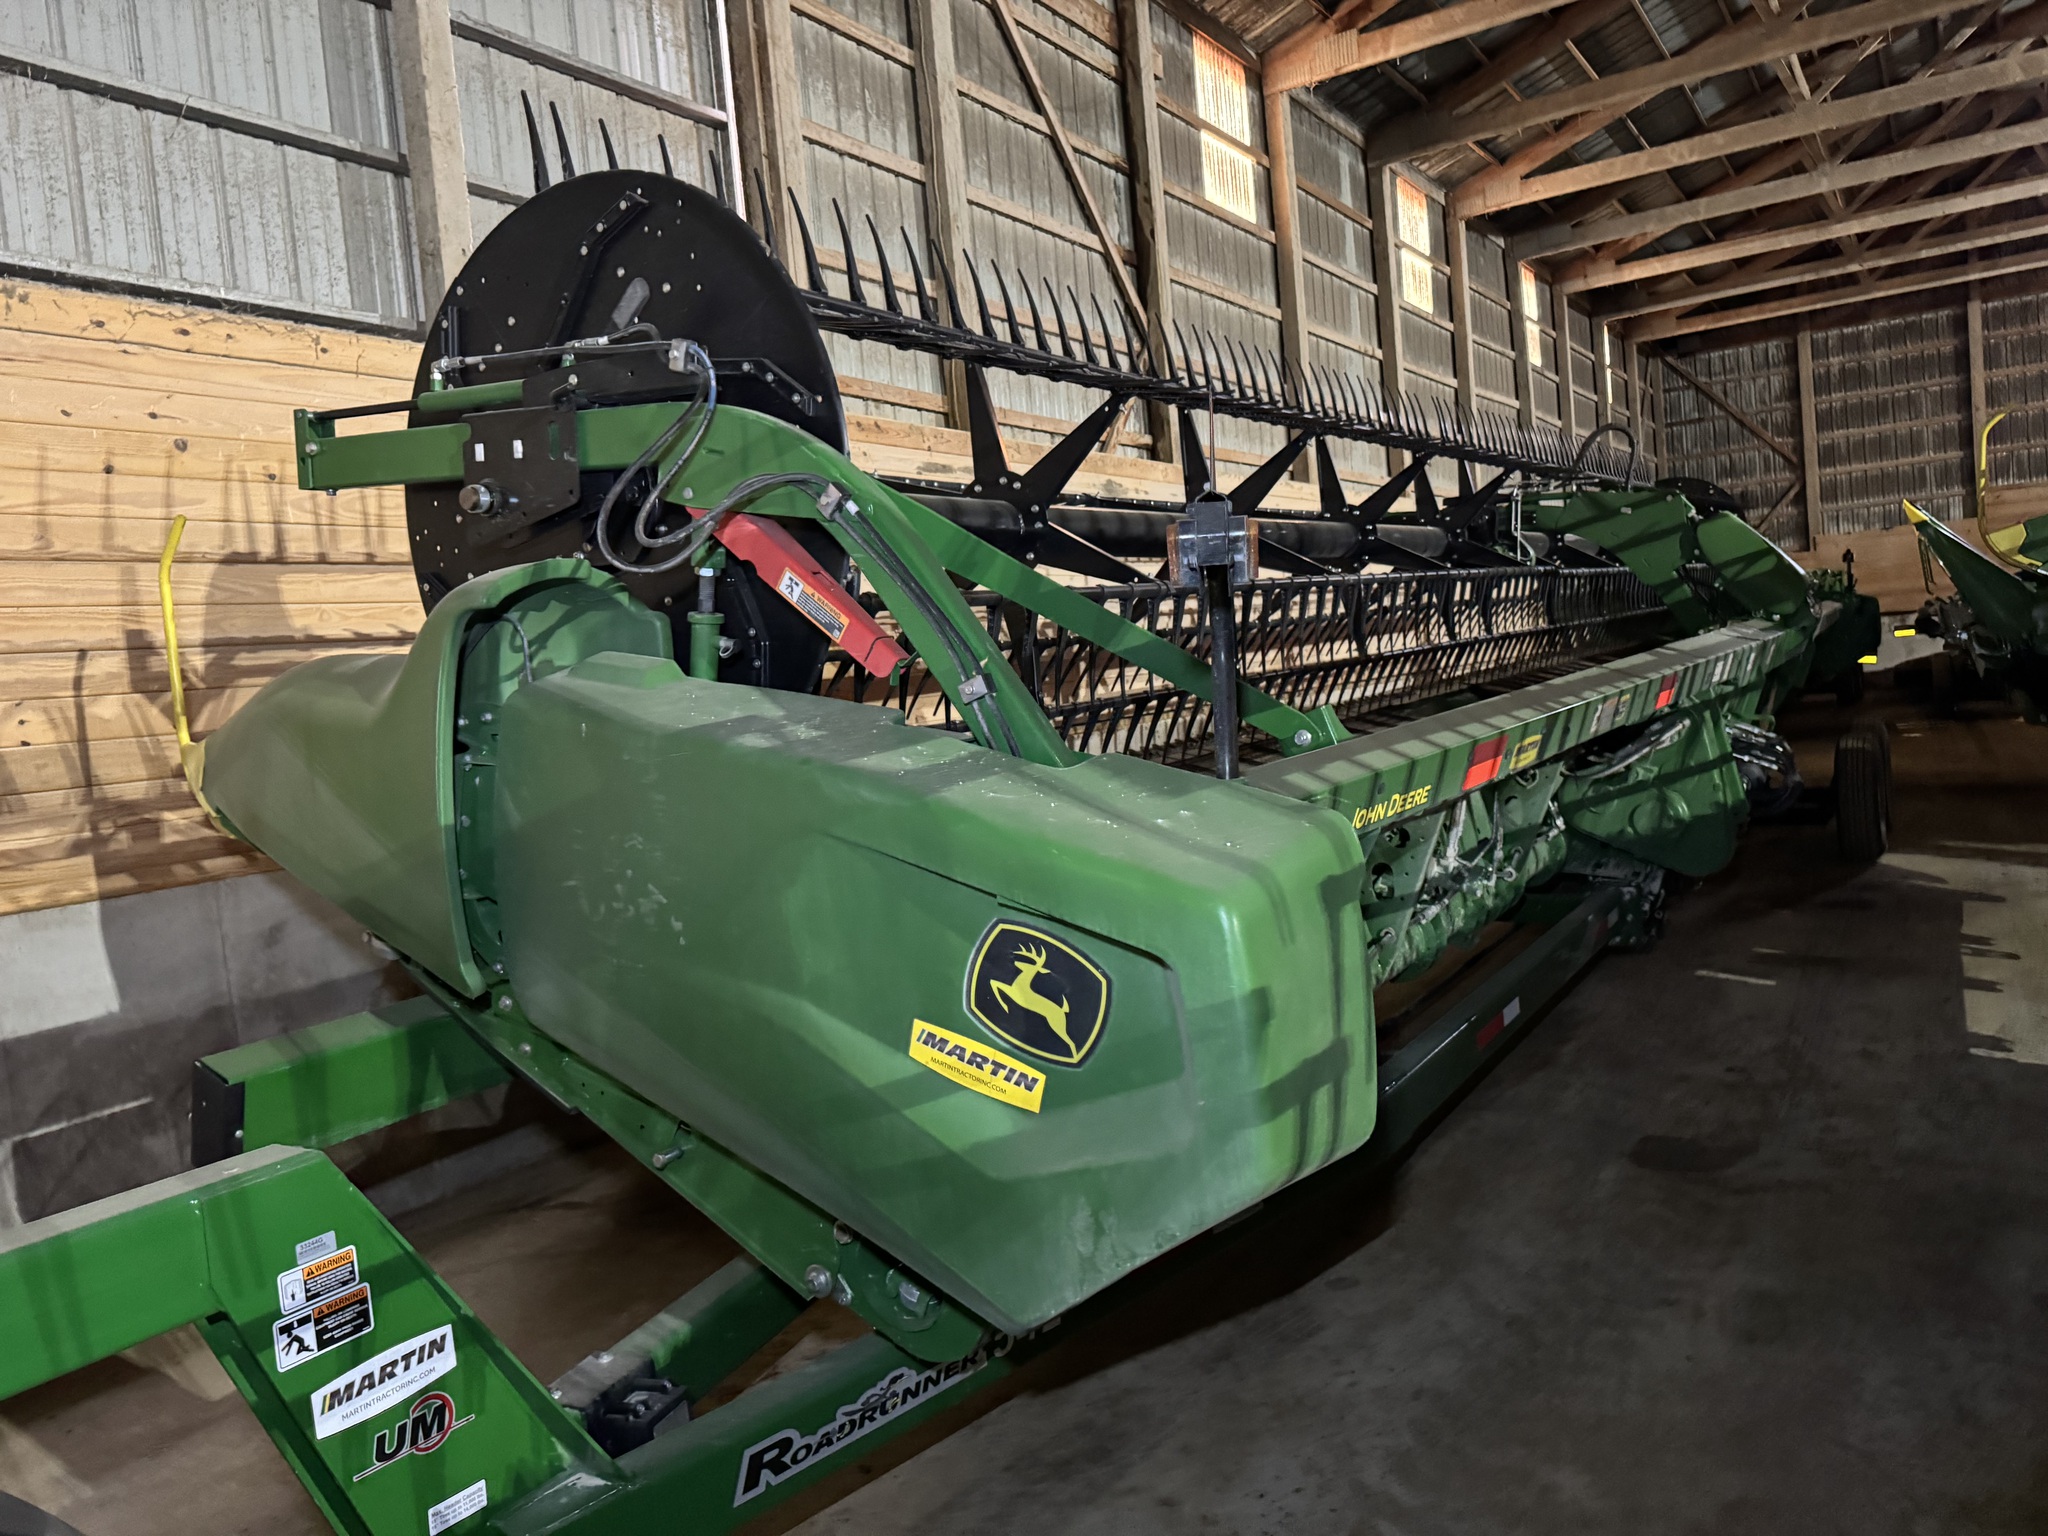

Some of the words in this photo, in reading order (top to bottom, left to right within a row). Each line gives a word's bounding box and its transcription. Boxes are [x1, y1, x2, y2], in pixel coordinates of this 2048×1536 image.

[816, 595, 842, 619] WARNING
[1352, 800, 1388, 830] JOHN
[1387, 785, 1432, 816] DEERE
[920, 1030, 1039, 1093] MARTIN
[930, 1056, 1007, 1095] MARTINTRACTORINC.COM
[315, 1251, 351, 1273] WARNING
[325, 1289, 365, 1312] WARNING
[324, 1332, 447, 1414] MARTIN
[341, 1366, 436, 1422] MARTINTRACTORINC.COM
[374, 1400, 448, 1463] UM
